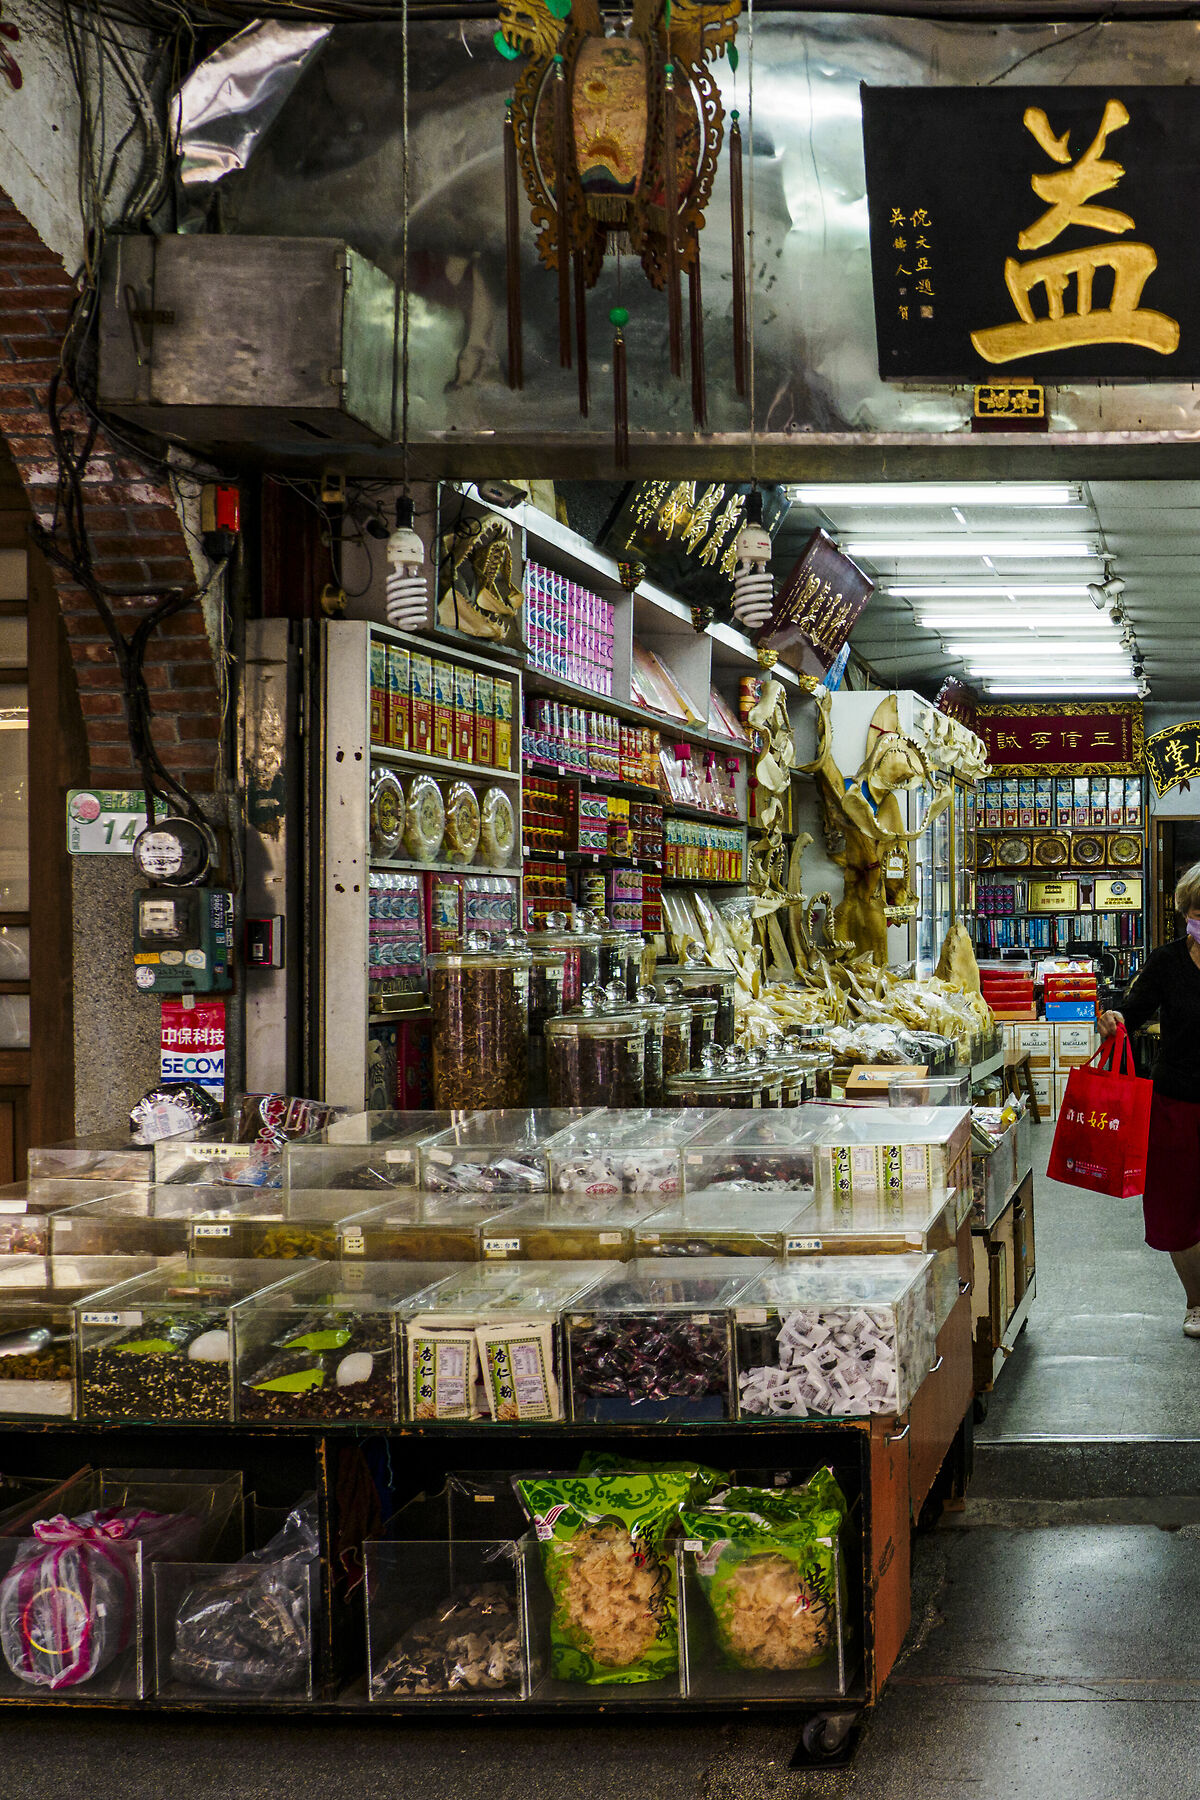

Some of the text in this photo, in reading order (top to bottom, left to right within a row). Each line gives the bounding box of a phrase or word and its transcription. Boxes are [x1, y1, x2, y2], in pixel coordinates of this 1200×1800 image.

[161, 1028, 225, 1046] 中保科技
[162, 1057, 225, 1074] SECOM
[837, 1148, 851, 1191] 杏仁粉
[888, 1146, 901, 1189] 杏仁粉
[419, 1347, 435, 1399] 杏仁粉
[494, 1348, 514, 1399] 杏仁粉
